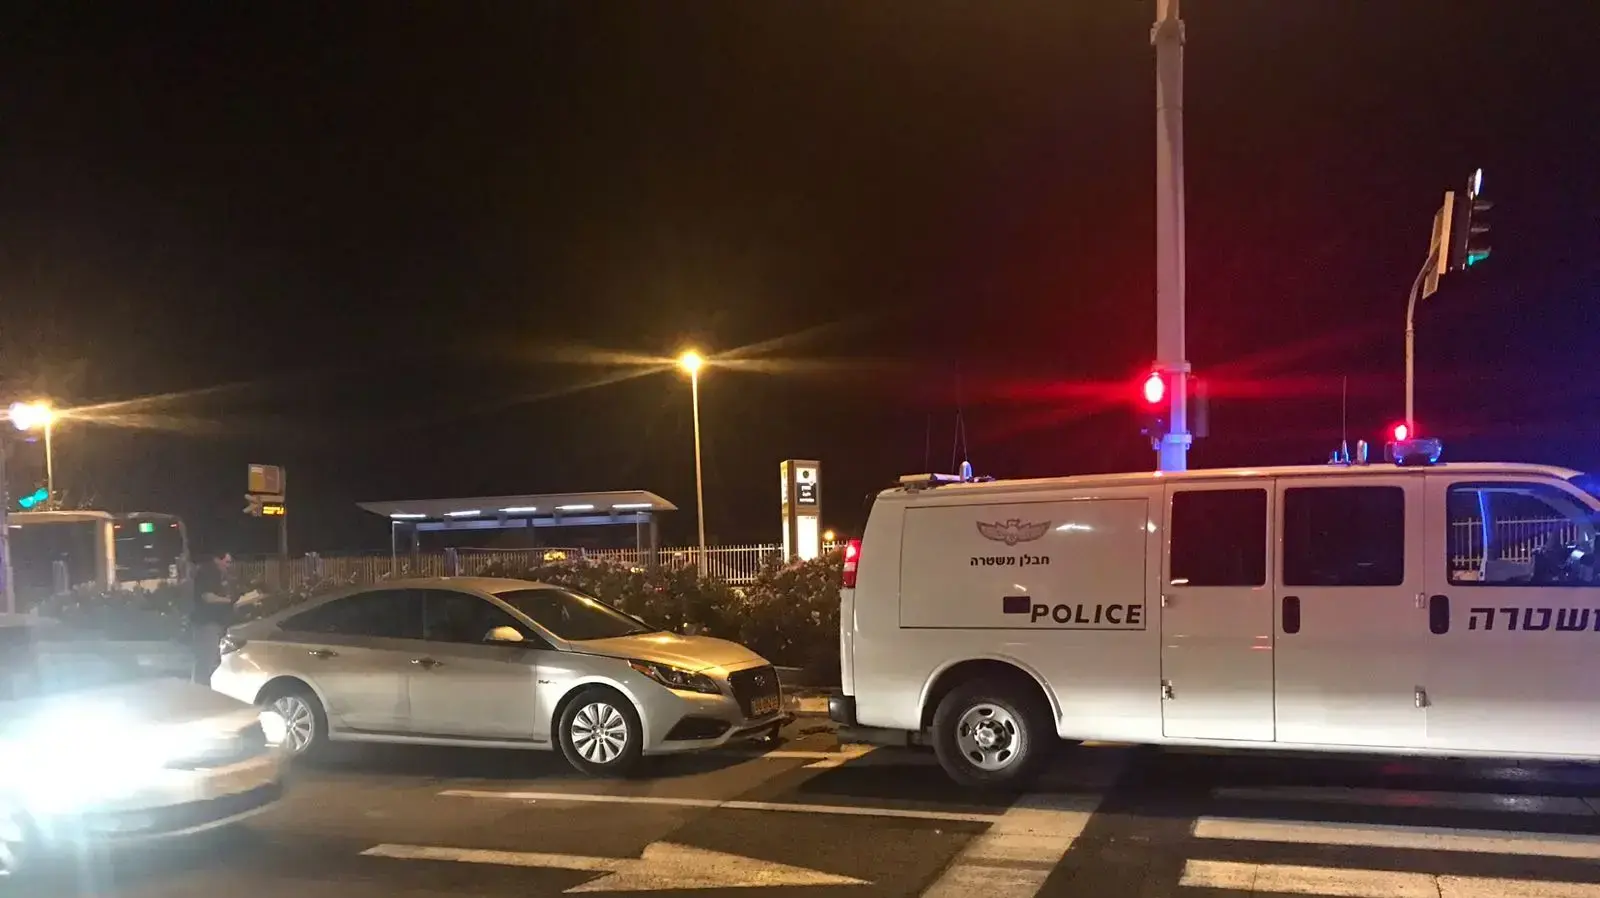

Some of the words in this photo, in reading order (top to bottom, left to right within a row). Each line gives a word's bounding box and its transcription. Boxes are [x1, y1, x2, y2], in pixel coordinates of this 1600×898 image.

[970, 556, 1016, 566] משטרה
[1019, 554, 1050, 567] חבלן
[1030, 604, 1142, 624] POLICE
[1468, 608, 1600, 632] שטרה
